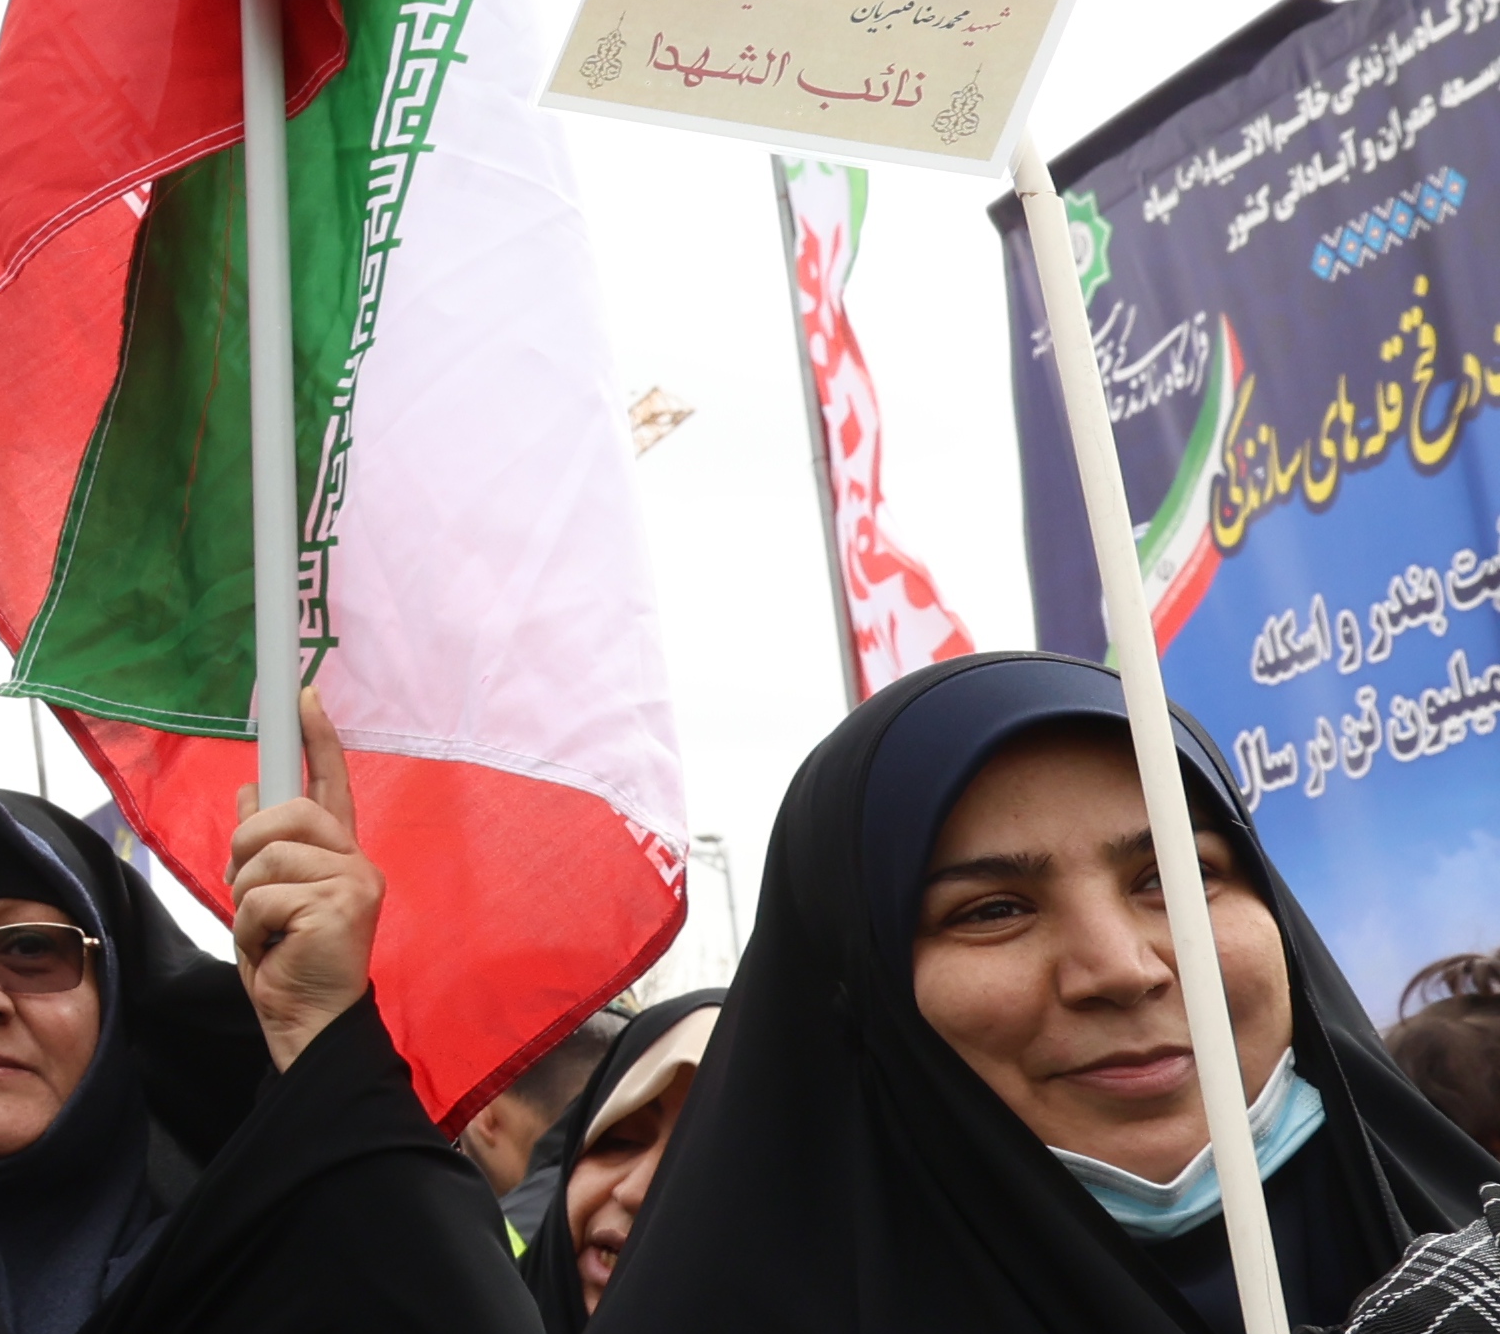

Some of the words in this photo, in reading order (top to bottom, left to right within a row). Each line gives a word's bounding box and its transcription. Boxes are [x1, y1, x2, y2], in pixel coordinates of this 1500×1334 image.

[646, 31, 791, 88] الشهدا
[960, 7, 1011, 47] شهید
[797, 62, 927, 111] نائب
[1332, 30, 1417, 116] سازندگی
[1360, 137, 1378, 174] و
[1376, 93, 1438, 161] عمران
[1273, 126, 1358, 223] آبادانی
[1226, 183, 1271, 254] کشور
[1211, 372, 1303, 549] سازندگی
[1251, 593, 1333, 685] اسکله
[1336, 608, 1363, 674] و
[1366, 564, 1449, 663] بندر
[1234, 725, 1299, 814] سال
[1305, 716, 1338, 799] در
[1340, 684, 1383, 779] تن
